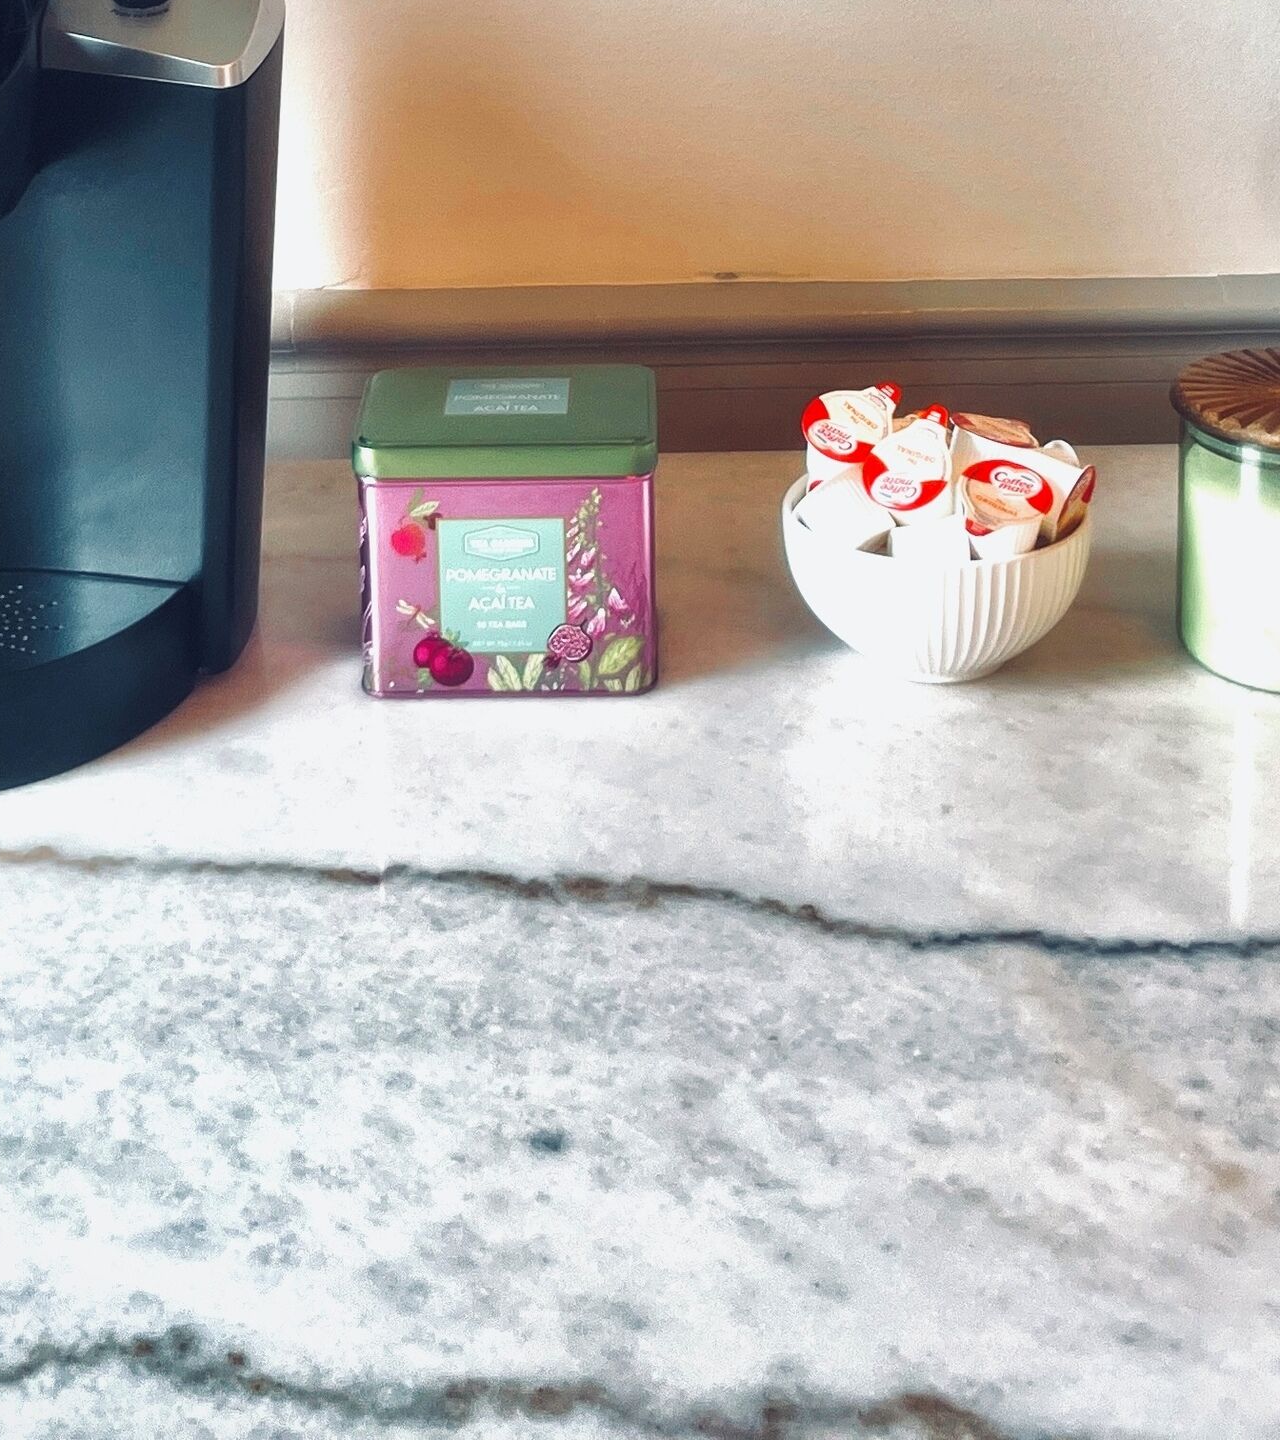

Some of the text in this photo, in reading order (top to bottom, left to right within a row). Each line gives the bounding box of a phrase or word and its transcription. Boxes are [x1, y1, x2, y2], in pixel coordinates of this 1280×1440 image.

[994, 471, 1034, 489] Coffee
[998, 482, 1032, 495] mate
[445, 566, 557, 583] POMEGRANATE
[507, 594, 536, 610] TEA
